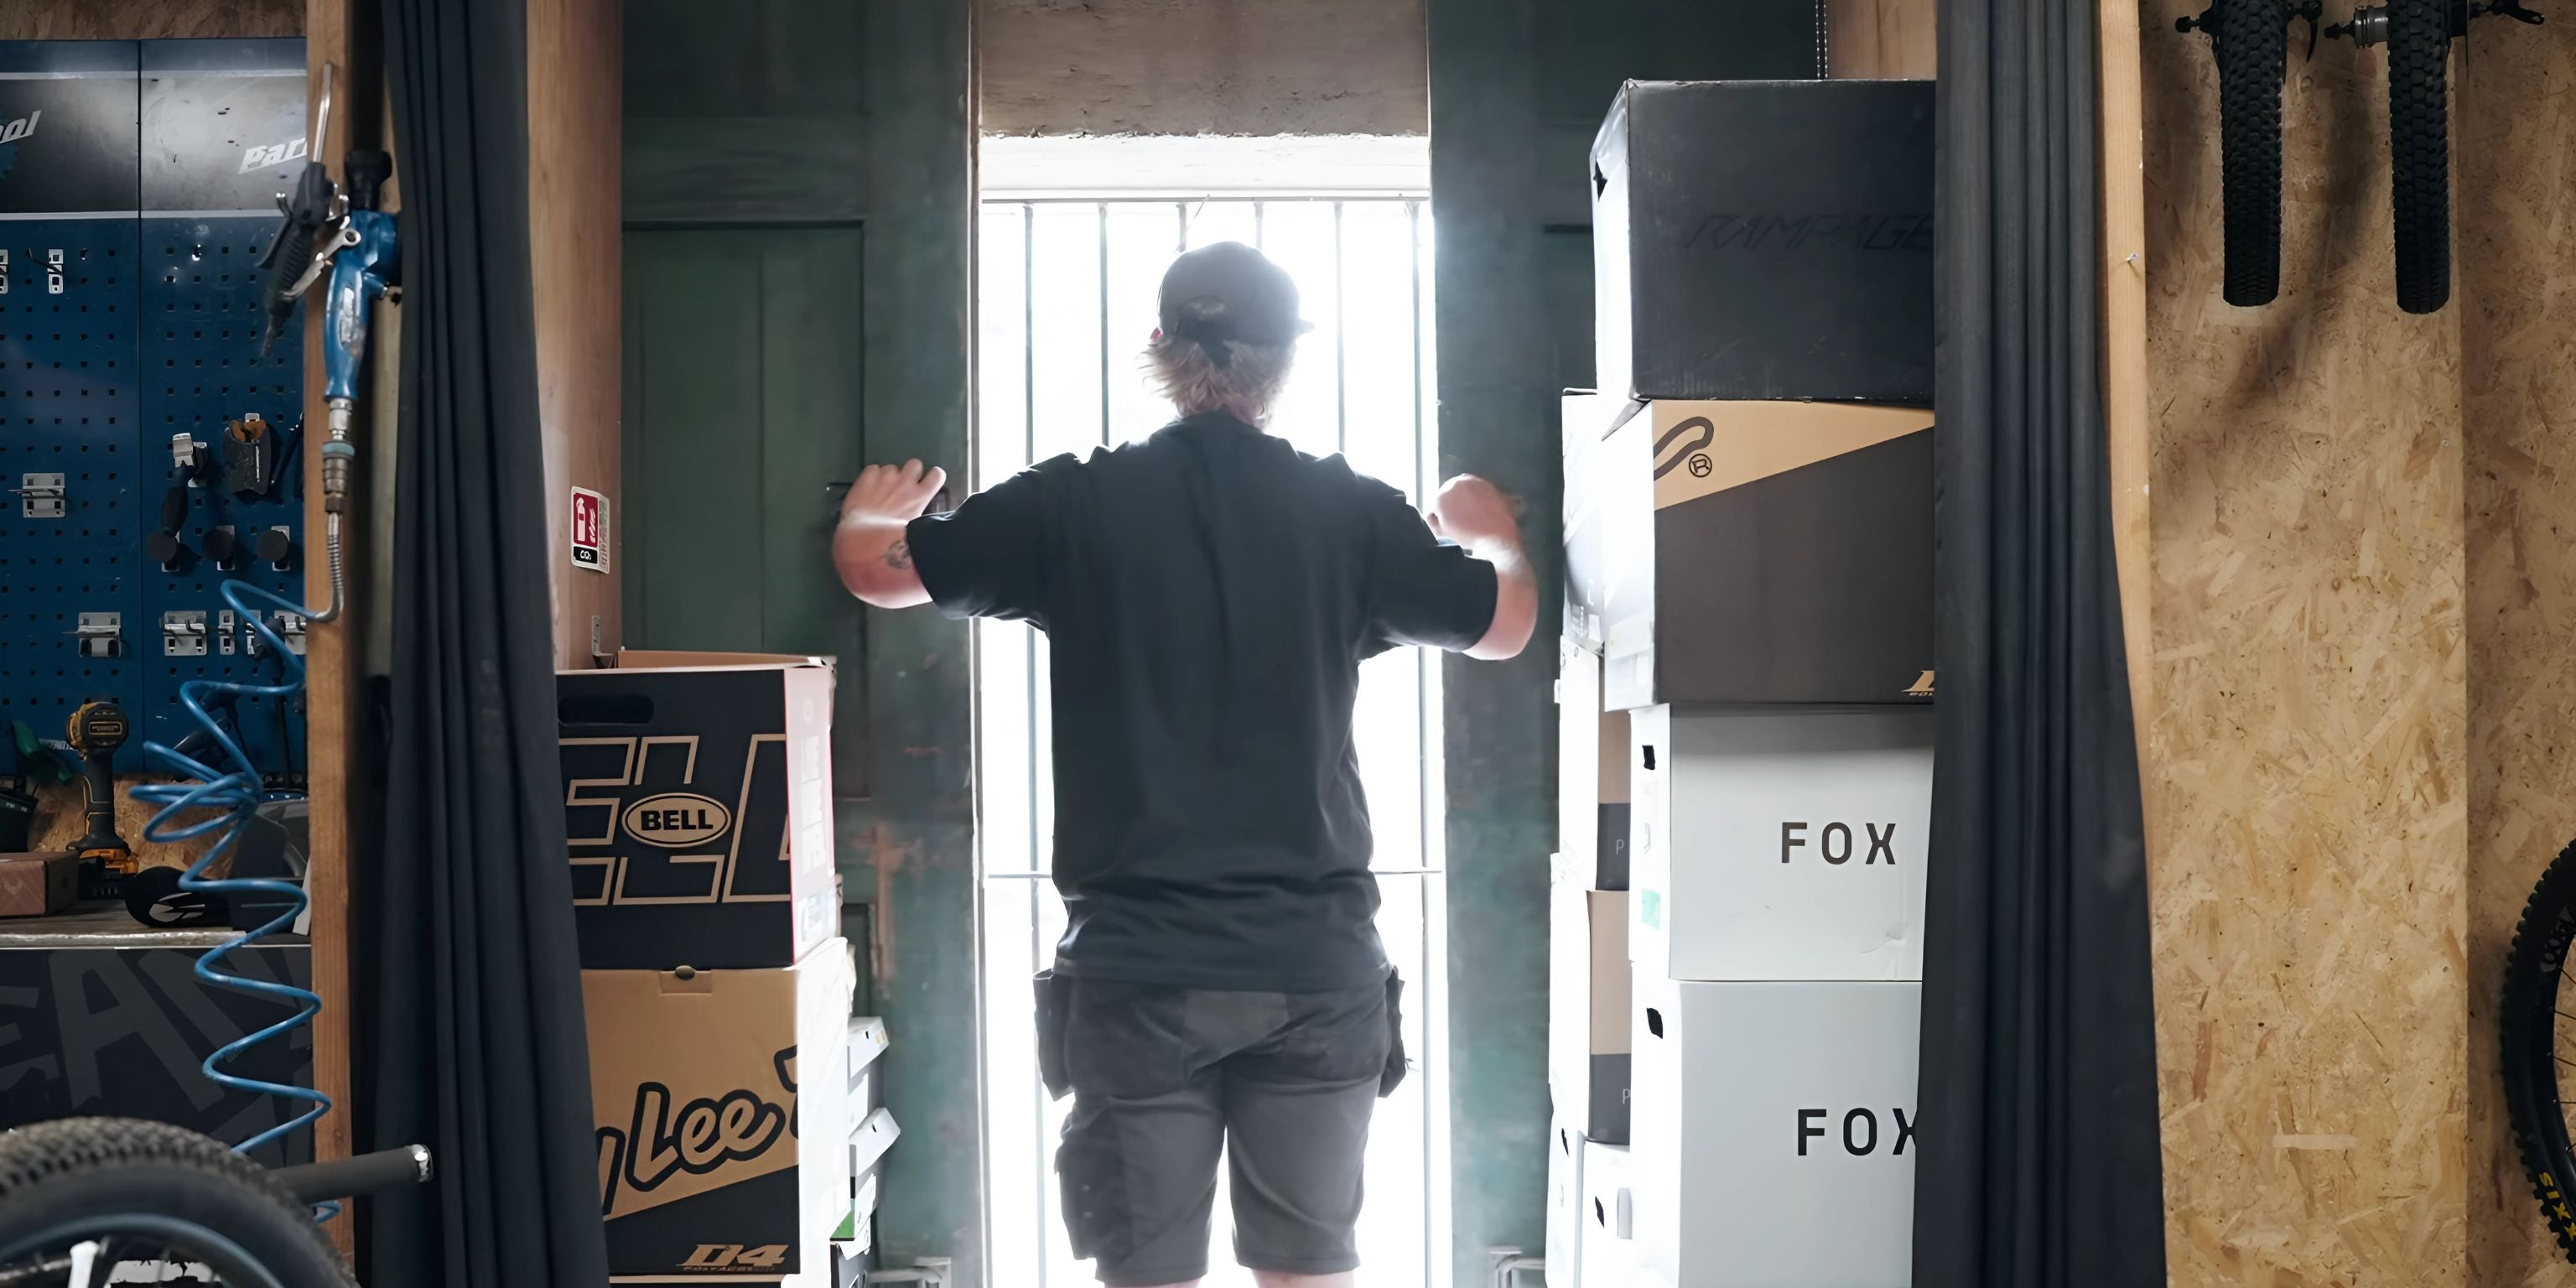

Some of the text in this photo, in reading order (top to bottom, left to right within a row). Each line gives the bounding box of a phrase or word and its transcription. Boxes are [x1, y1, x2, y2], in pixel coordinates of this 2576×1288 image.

[238, 138, 307, 174] Par
[641, 809, 714, 831] BELL
[1781, 822, 1896, 865] FOX
[1798, 1108, 1917, 1156] FOX
[676, 1244, 789, 1267] D4
